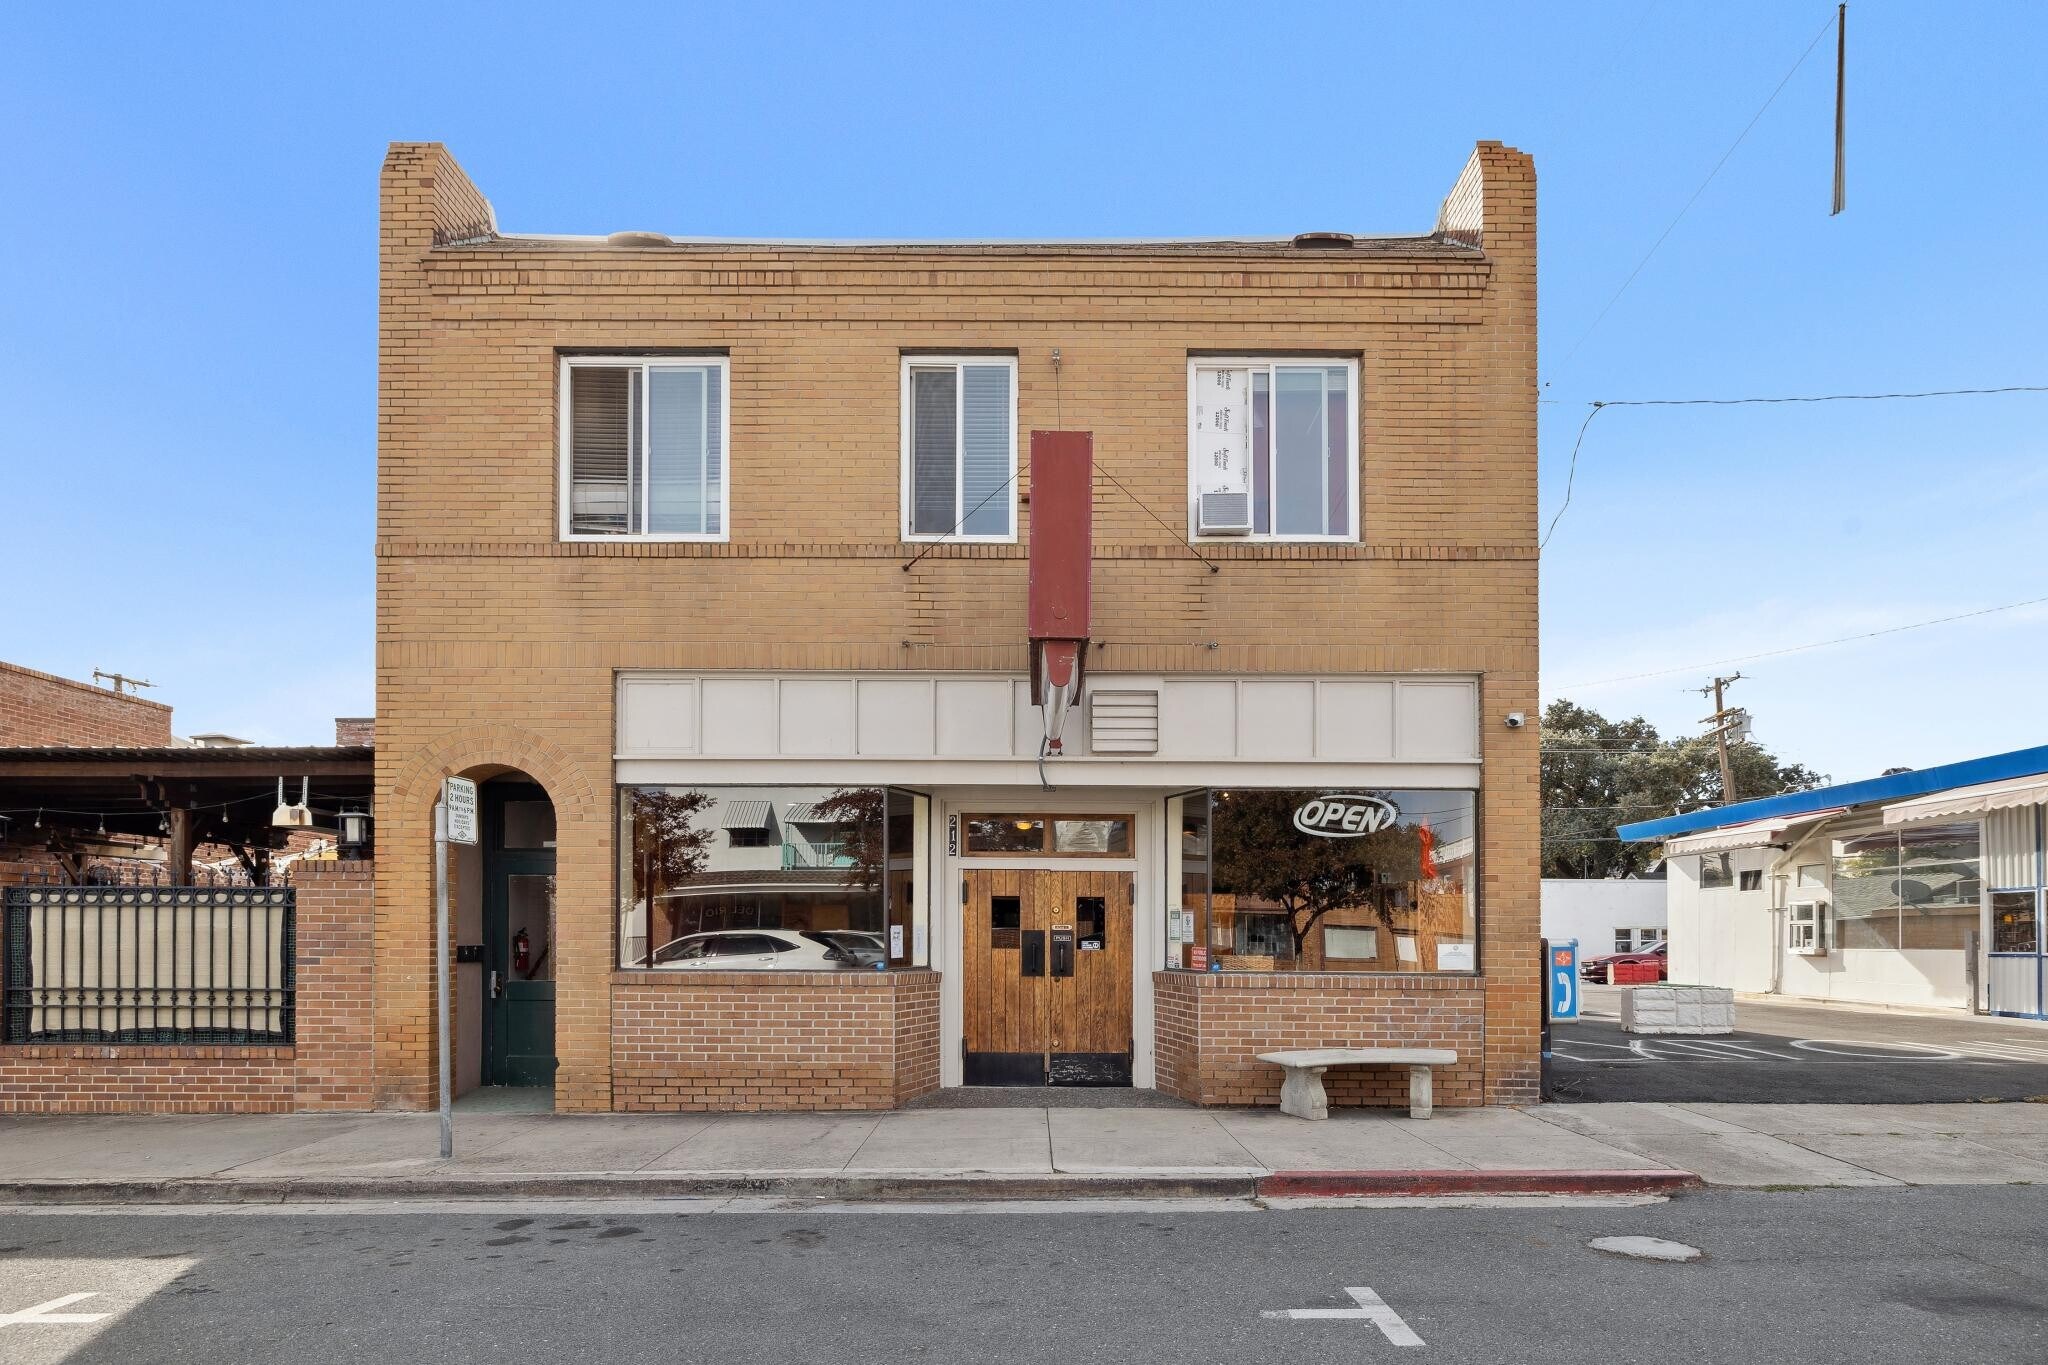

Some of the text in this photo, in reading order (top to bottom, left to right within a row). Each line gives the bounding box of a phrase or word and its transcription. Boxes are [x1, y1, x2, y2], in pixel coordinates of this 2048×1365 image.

[450, 783, 474, 795] PARKING
[450, 793, 474, 805] 2 HOURS
[1300, 800, 1386, 833] OPEN
